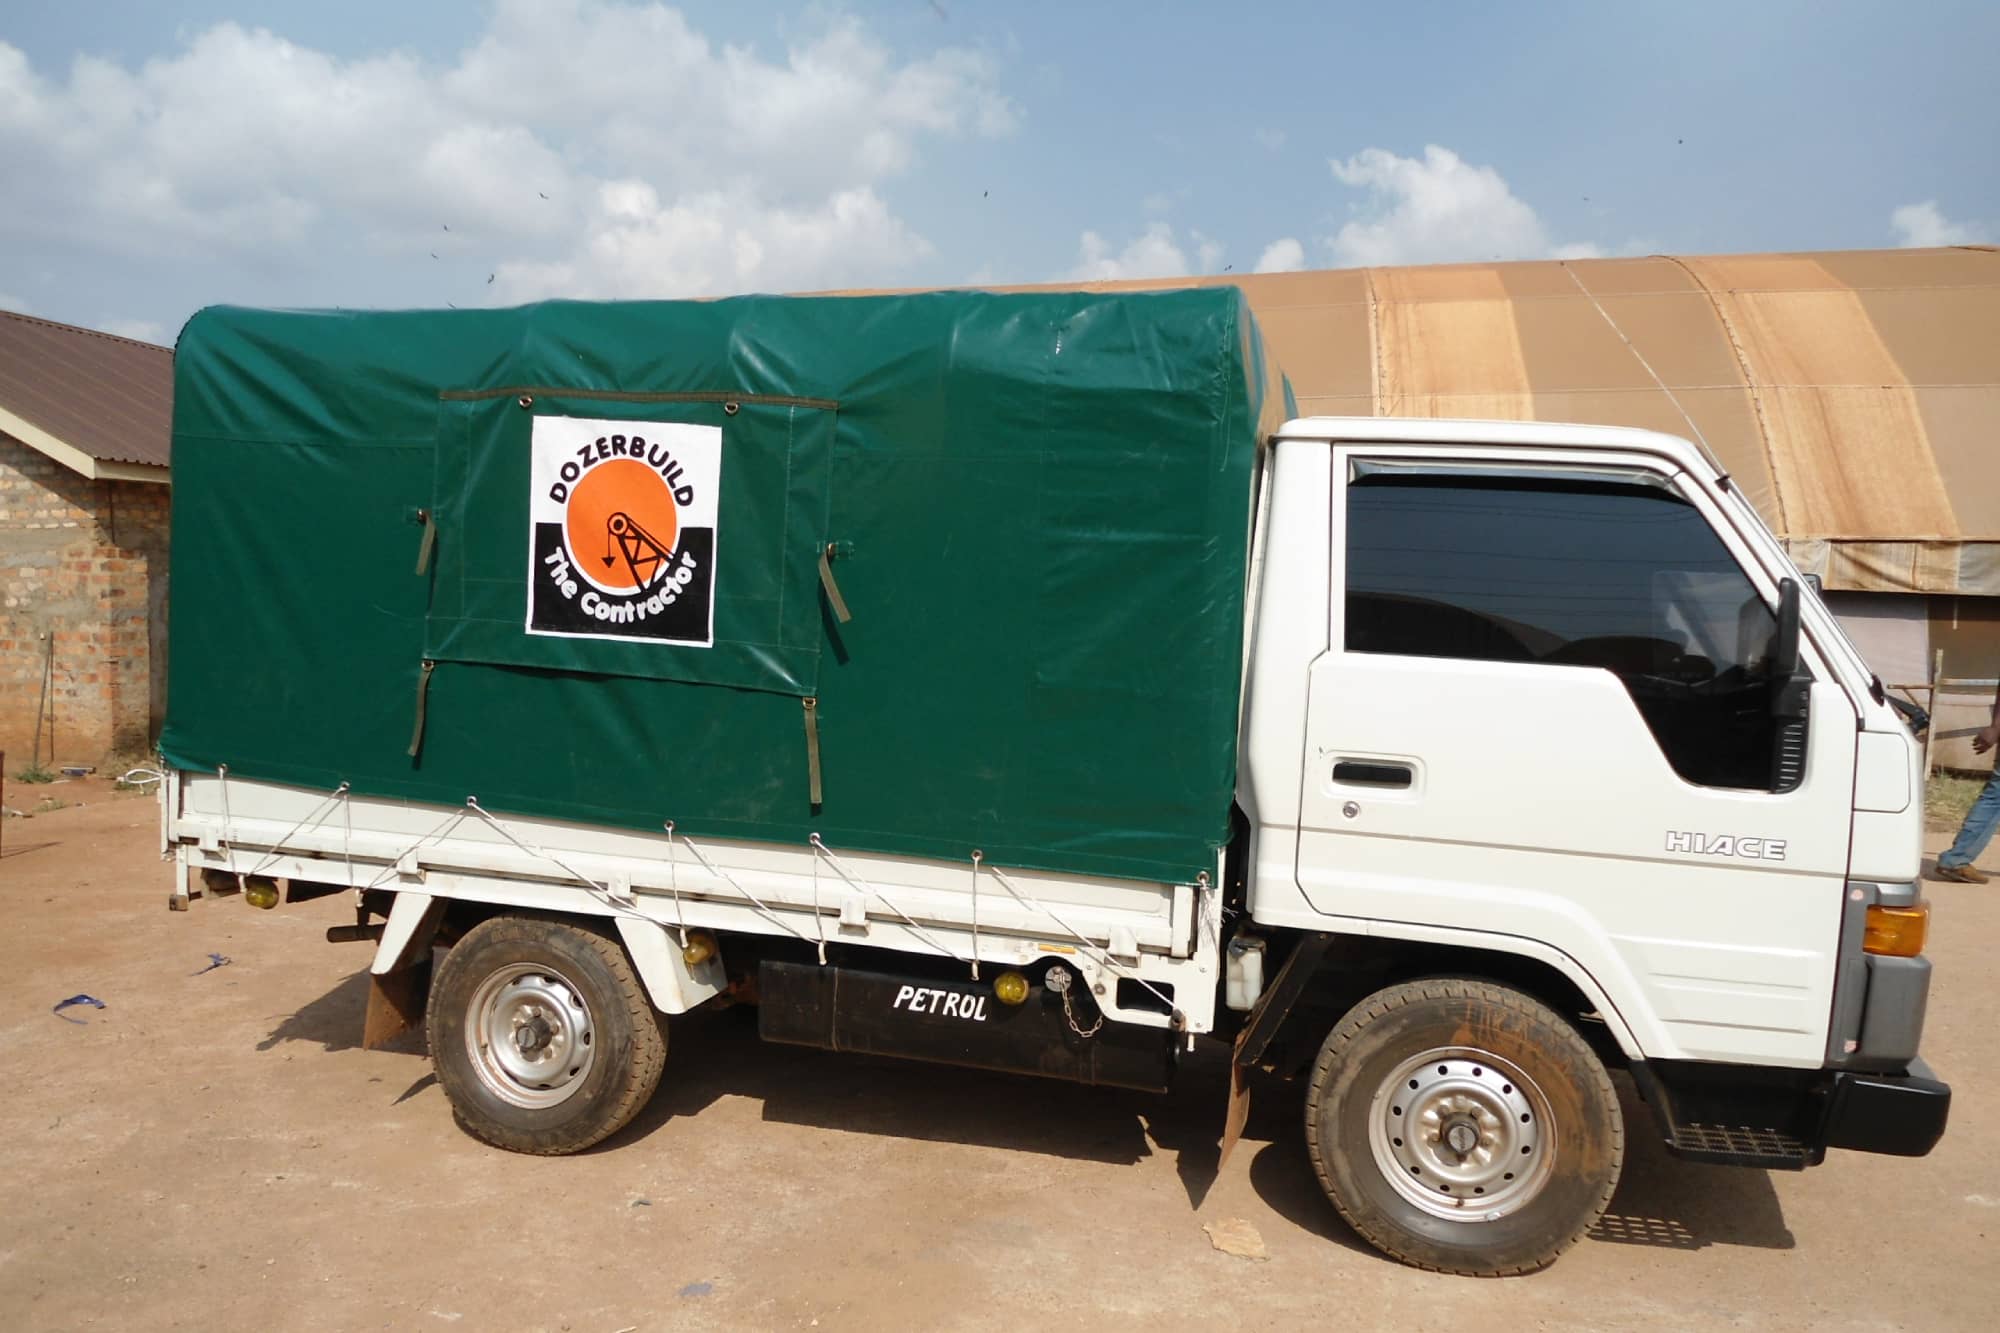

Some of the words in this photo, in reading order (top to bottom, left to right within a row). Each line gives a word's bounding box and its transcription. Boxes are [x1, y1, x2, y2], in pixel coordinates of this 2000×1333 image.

[549, 434, 694, 507] DOZERBUILD
[544, 546, 578, 600] The
[580, 551, 697, 624] Contractor
[1665, 830, 1787, 861] HIACE
[892, 984, 987, 1022] PETROL
